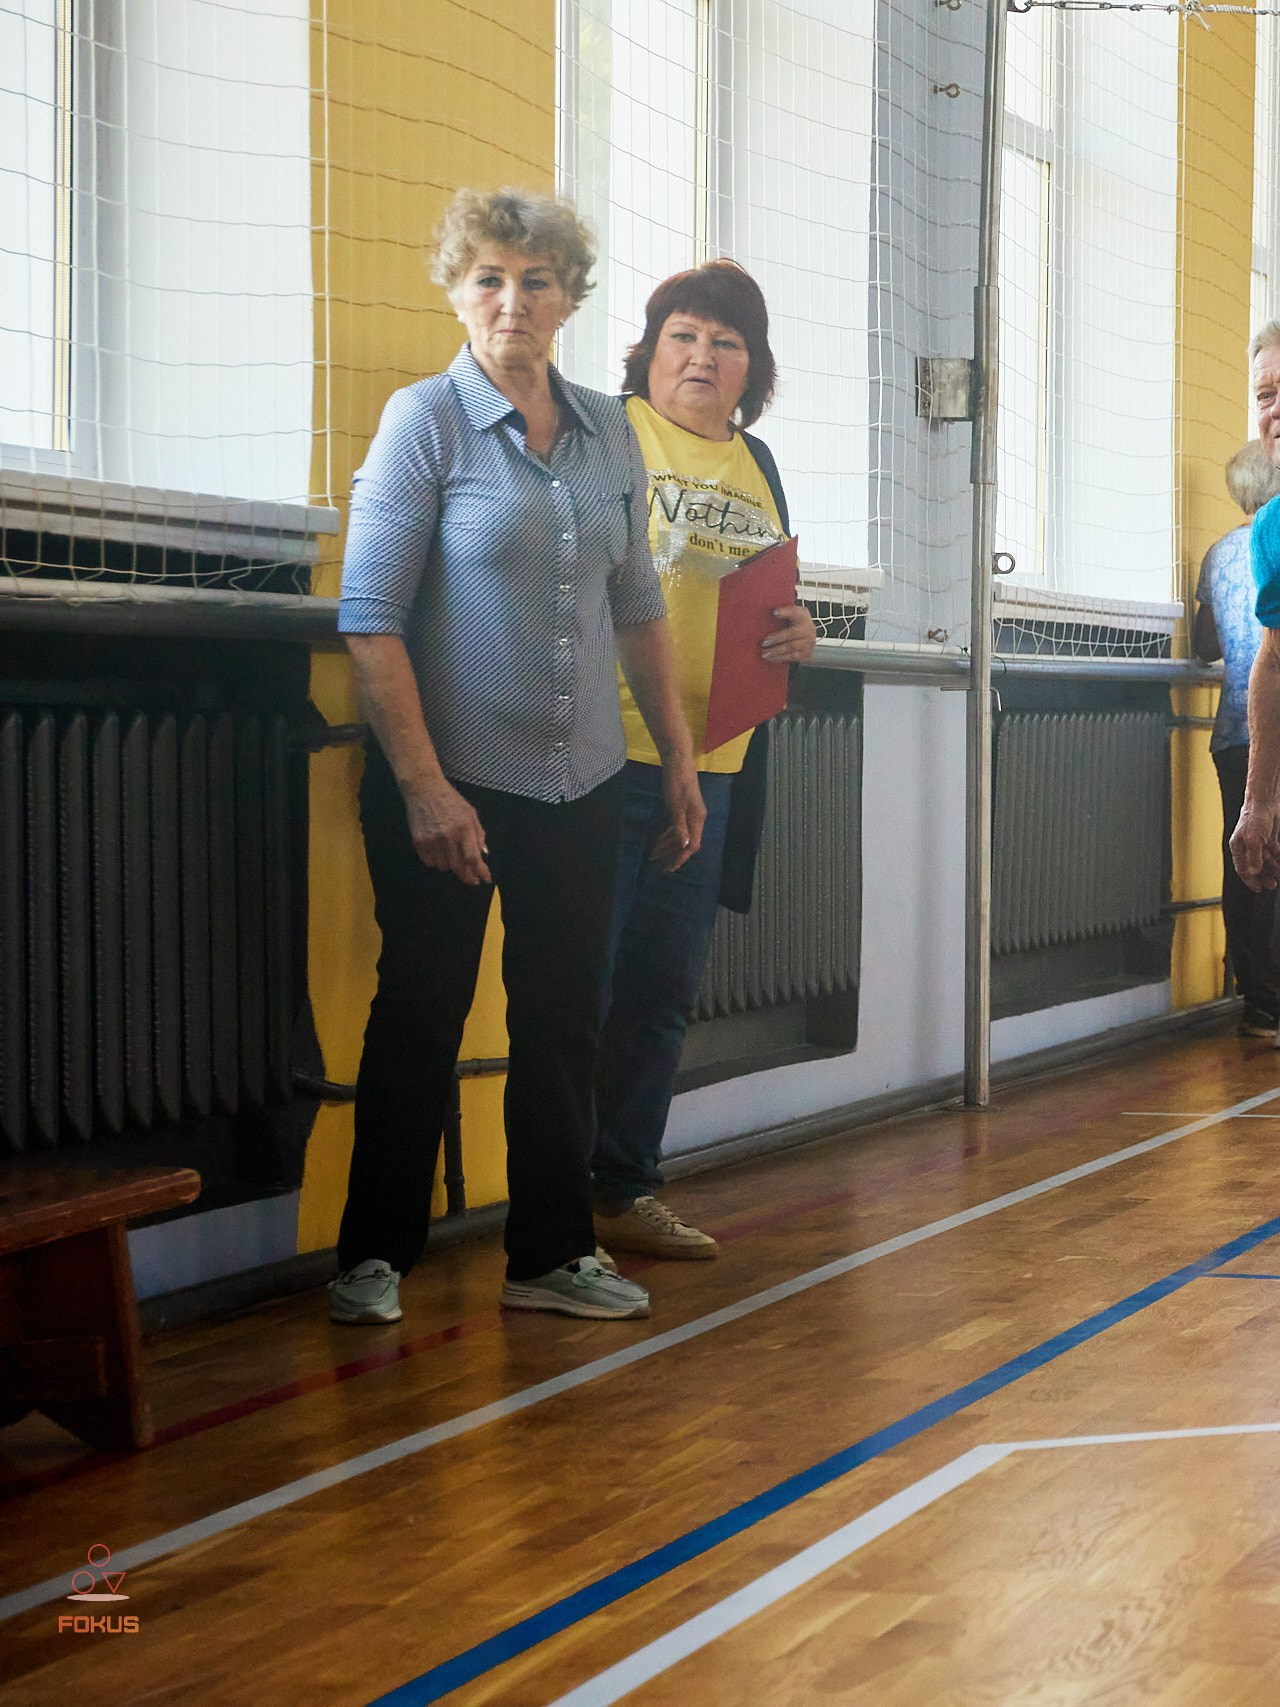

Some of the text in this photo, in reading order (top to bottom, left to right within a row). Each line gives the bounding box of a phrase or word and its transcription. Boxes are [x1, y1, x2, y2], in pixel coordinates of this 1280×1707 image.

[653, 474, 763, 509] WHAT YOU IMAGINE
[648, 486, 774, 540] Nothin
[689, 533, 750, 557] don't me
